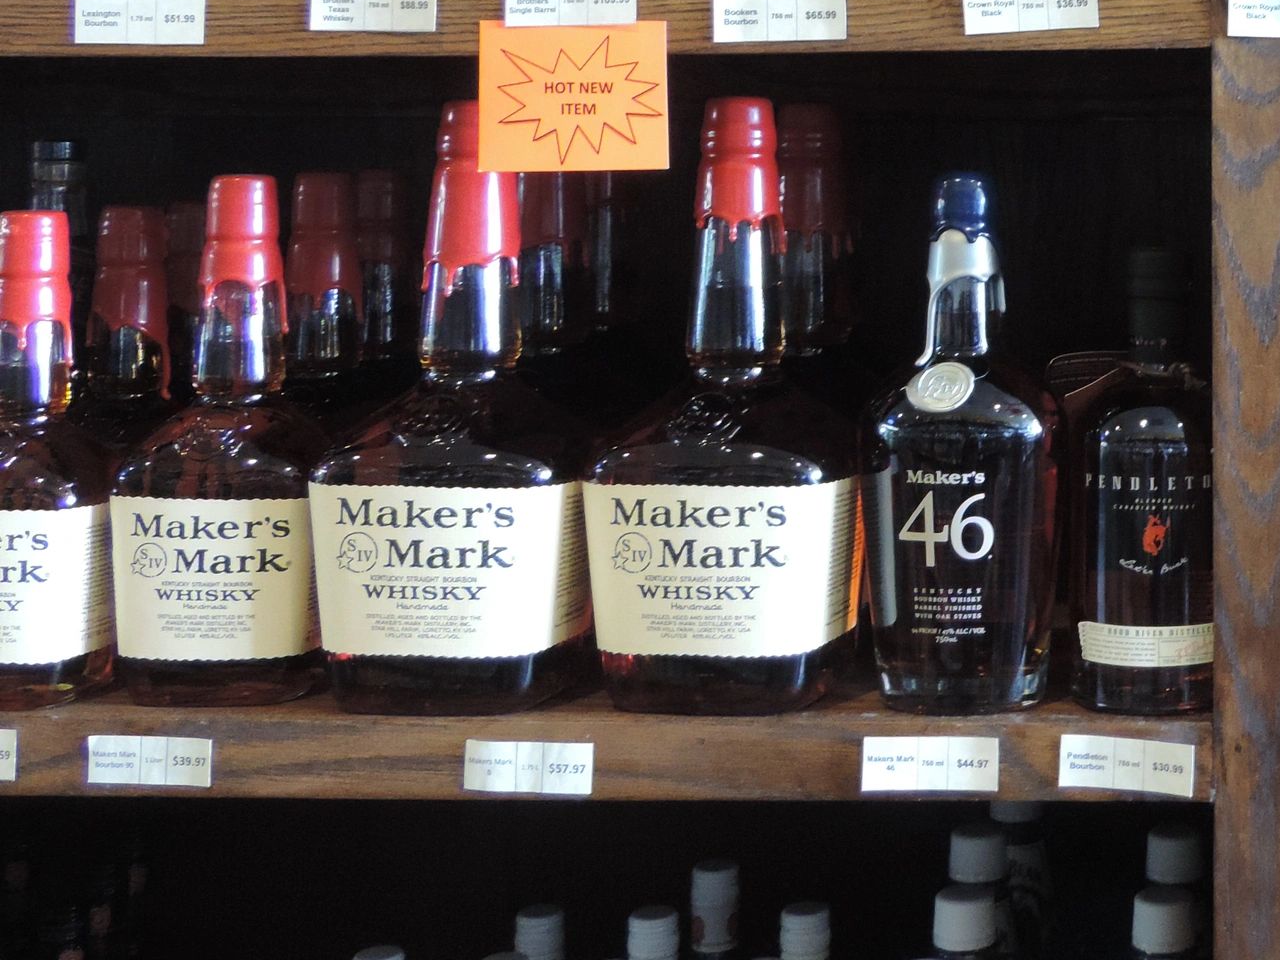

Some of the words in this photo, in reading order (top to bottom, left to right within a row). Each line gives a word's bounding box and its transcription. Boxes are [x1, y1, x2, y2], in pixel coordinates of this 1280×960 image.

[81, 9, 121, 20] Lexington
[509, 6, 534, 15] Single
[724, 8, 758, 16] Bookers
[84, 19, 119, 28] Bourbon
[723, 18, 759, 26] Bourbon
[544, 81, 575, 94] HOT
[579, 81, 613, 94] NEW
[560, 103, 597, 115] ITEM
[906, 470, 985, 485] Maker's
[1085, 472, 1213, 492] PENDLETO
[335, 497, 515, 529] Maker's
[610, 497, 787, 528] Maker's
[131, 512, 291, 540] Maker's
[898, 490, 995, 568] 46
[384, 538, 513, 569] Mark
[657, 538, 786, 569] Mark
[171, 548, 288, 575] Mark
[370, 574, 404, 582] KENTUCKY
[406, 575, 440, 583] STRAIGHT
[154, 588, 261, 601] WHISKY
[362, 583, 487, 600] WHISKY
[637, 584, 761, 600] WHISKY
[396, 602, 449, 611] Handmade
[670, 602, 723, 611] Handmade
[172, 755, 206, 767] $39.97
[867, 755, 894, 763] Makers
[1066, 751, 1108, 761] Pendleton
[549, 763, 586, 774] $57.97
[956, 759, 989, 770] $44.97
[1069, 761, 1105, 771] Bourbon
[1152, 762, 1184, 775] $30.99
